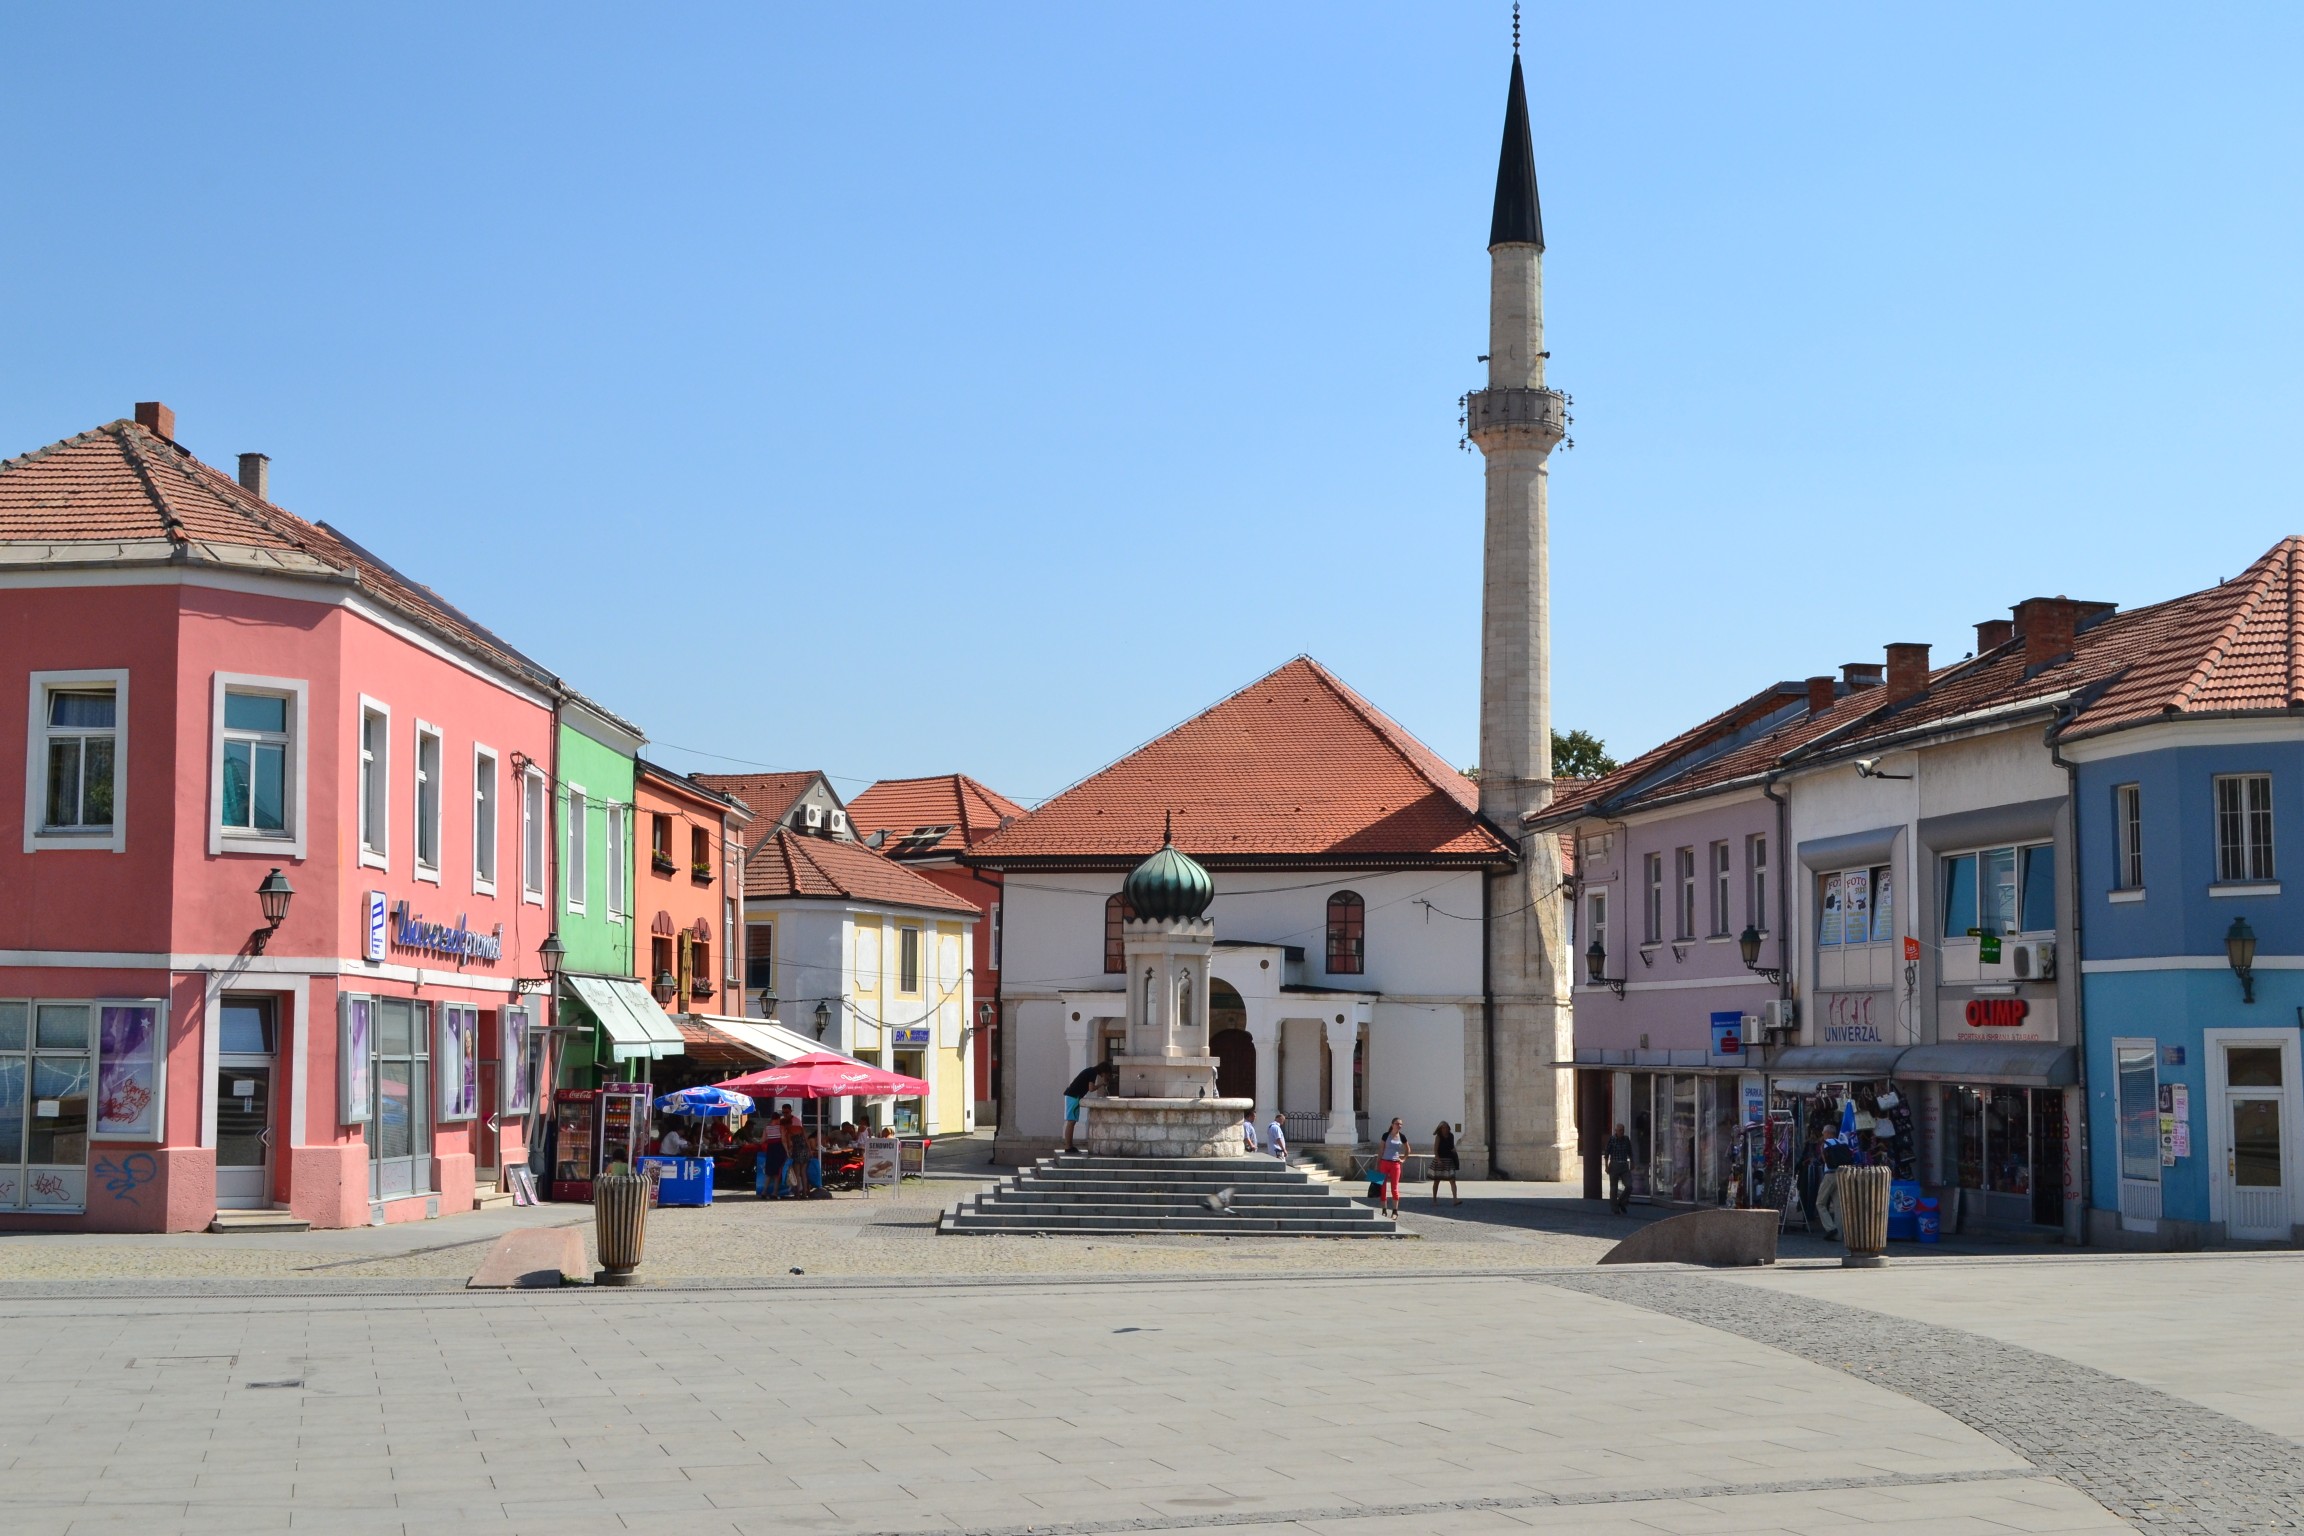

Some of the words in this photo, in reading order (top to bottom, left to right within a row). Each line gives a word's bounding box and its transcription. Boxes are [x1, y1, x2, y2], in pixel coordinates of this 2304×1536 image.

[1828, 878, 1841, 891] FOT
[1846, 876, 1867, 889] FOTO
[1966, 999, 2028, 1027] OLIMP
[1824, 1026, 1882, 1042] UNIVERZAL
